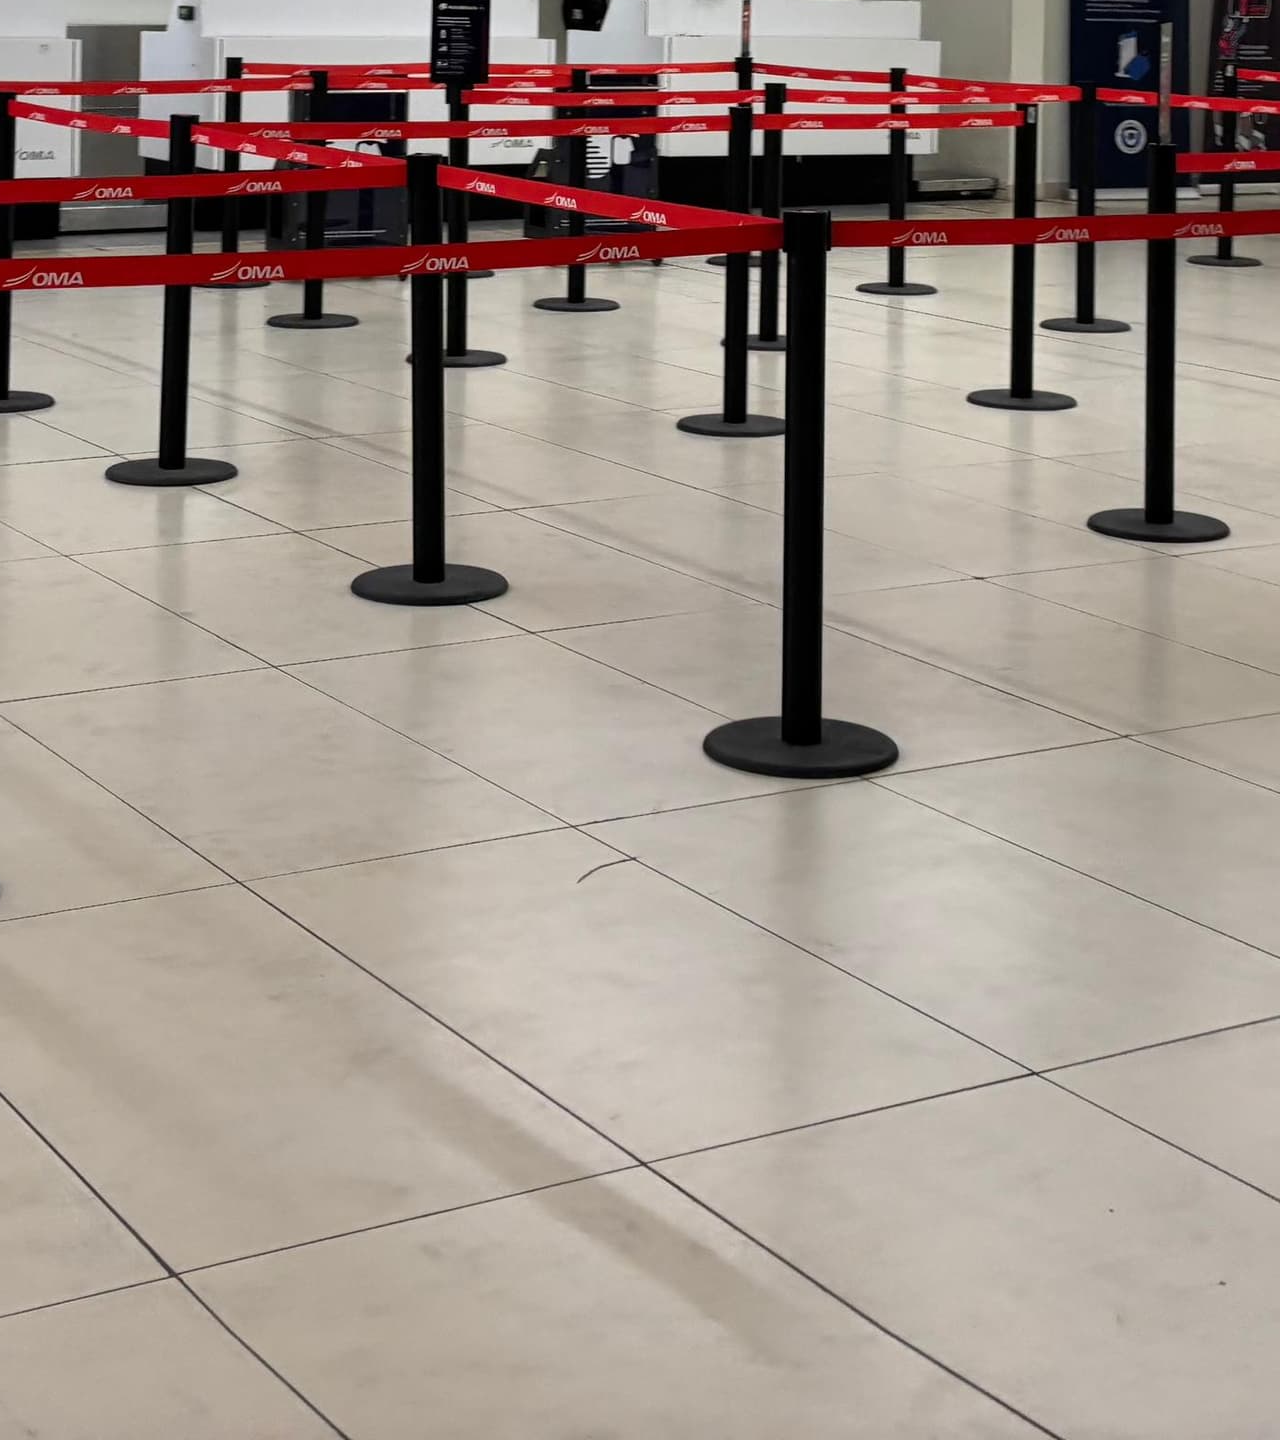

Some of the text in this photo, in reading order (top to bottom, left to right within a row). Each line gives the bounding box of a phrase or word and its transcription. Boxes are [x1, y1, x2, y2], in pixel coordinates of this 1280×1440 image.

[95, 187, 133, 199] OMA
[246, 181, 282, 193] OMA
[1055, 228, 1090, 241] OMA
[1190, 224, 1224, 235] OMA
[912, 232, 948, 244] OMA
[599, 246, 640, 259] OMA
[425, 256, 469, 272] OMA
[237, 265, 285, 280] OMA
[31, 271, 84, 288] OMA
